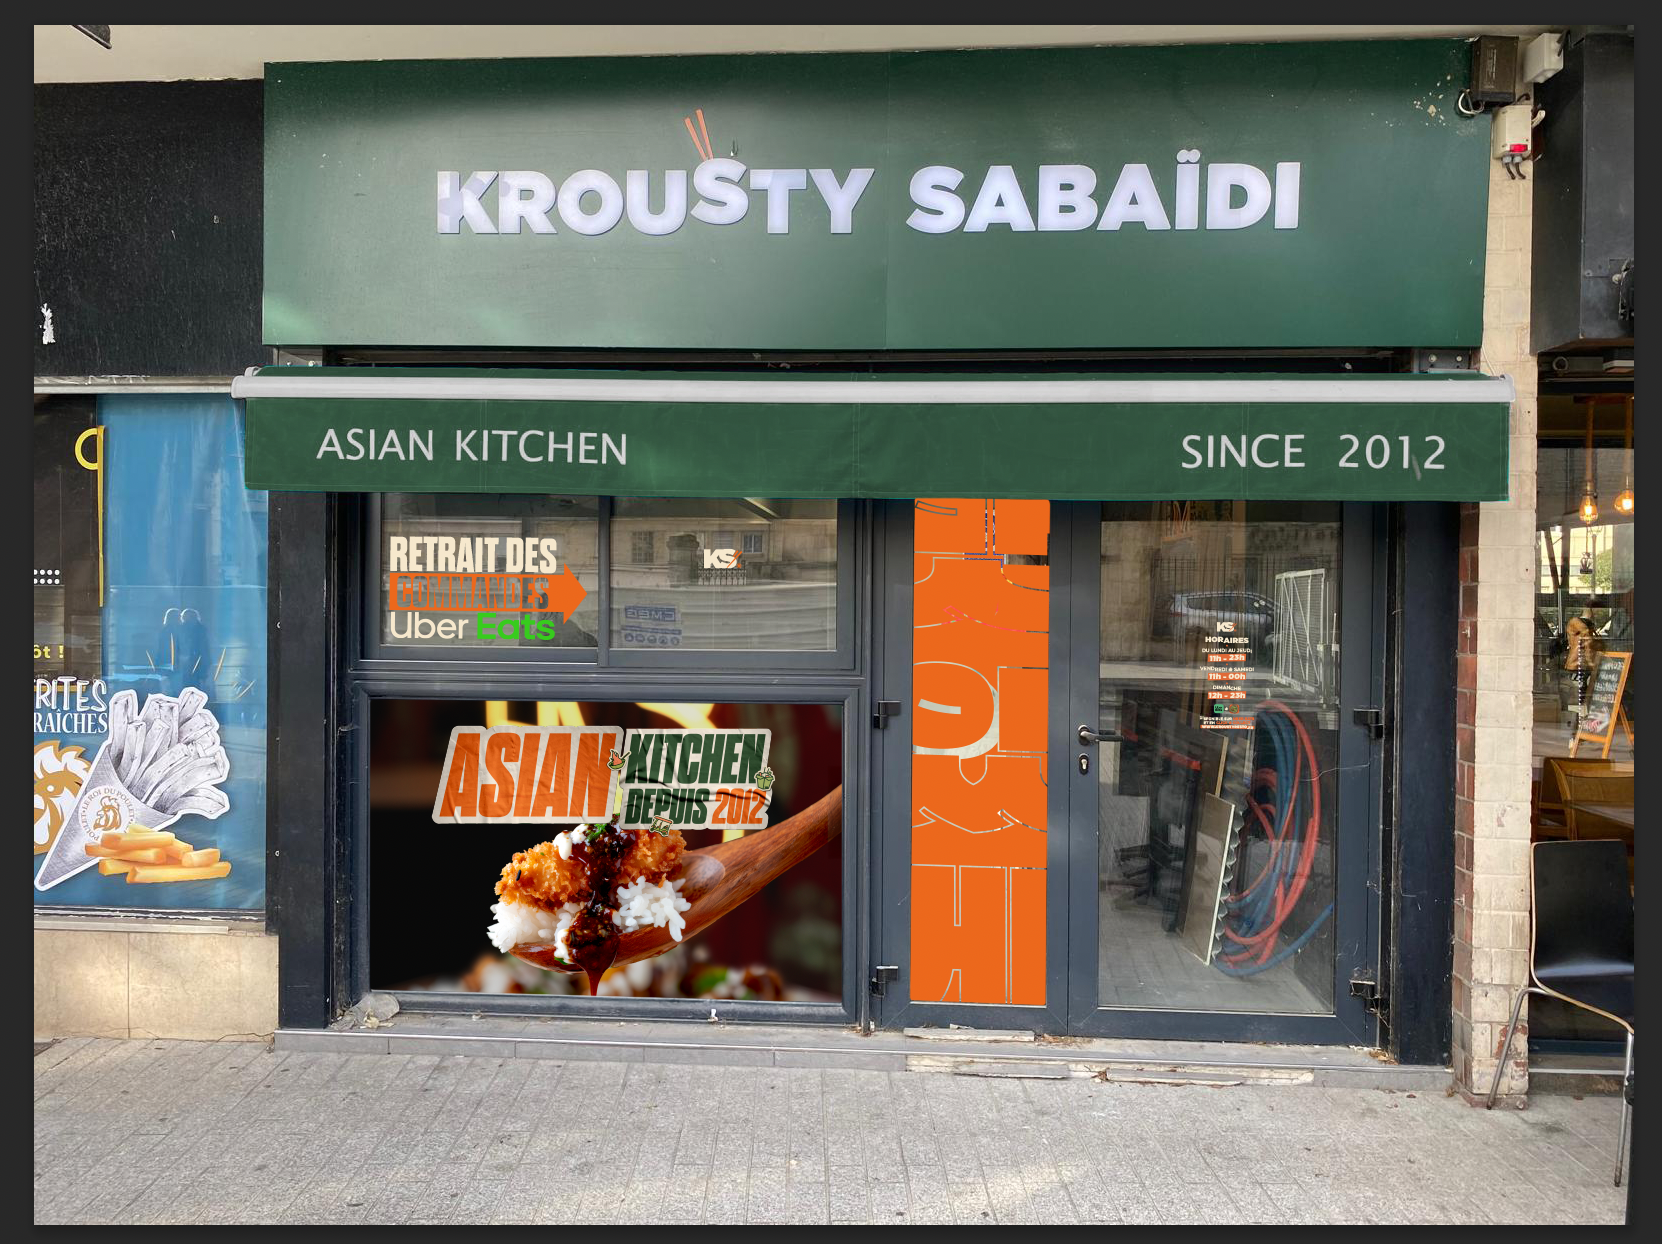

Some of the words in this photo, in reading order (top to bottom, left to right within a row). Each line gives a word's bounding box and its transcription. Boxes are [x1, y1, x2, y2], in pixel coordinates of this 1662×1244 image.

[437, 157, 875, 236] KROUSTY
[906, 147, 1302, 234] SABAÏDI
[316, 428, 435, 462] ASIAN
[455, 430, 628, 466] KITCHEN
[1181, 432, 1307, 470] SINCE
[1338, 433, 1446, 470] 2012
[390, 535, 500, 573] RETRAIT
[506, 536, 557, 574] DES
[396, 575, 550, 611] COMMANDES
[390, 611, 468, 640] Uber
[477, 611, 556, 641] Eats
[1204, 636, 1249, 644] HORAIRES
[34, 676, 108, 712] RITES
[438, 732, 617, 818] ASIAN
[624, 733, 768, 785] KITCHEN
[87, 789, 102, 803] ROI
[104, 787, 117, 795] DU
[624, 788, 710, 825] DEPUIS
[711, 787, 768, 825] 2012
